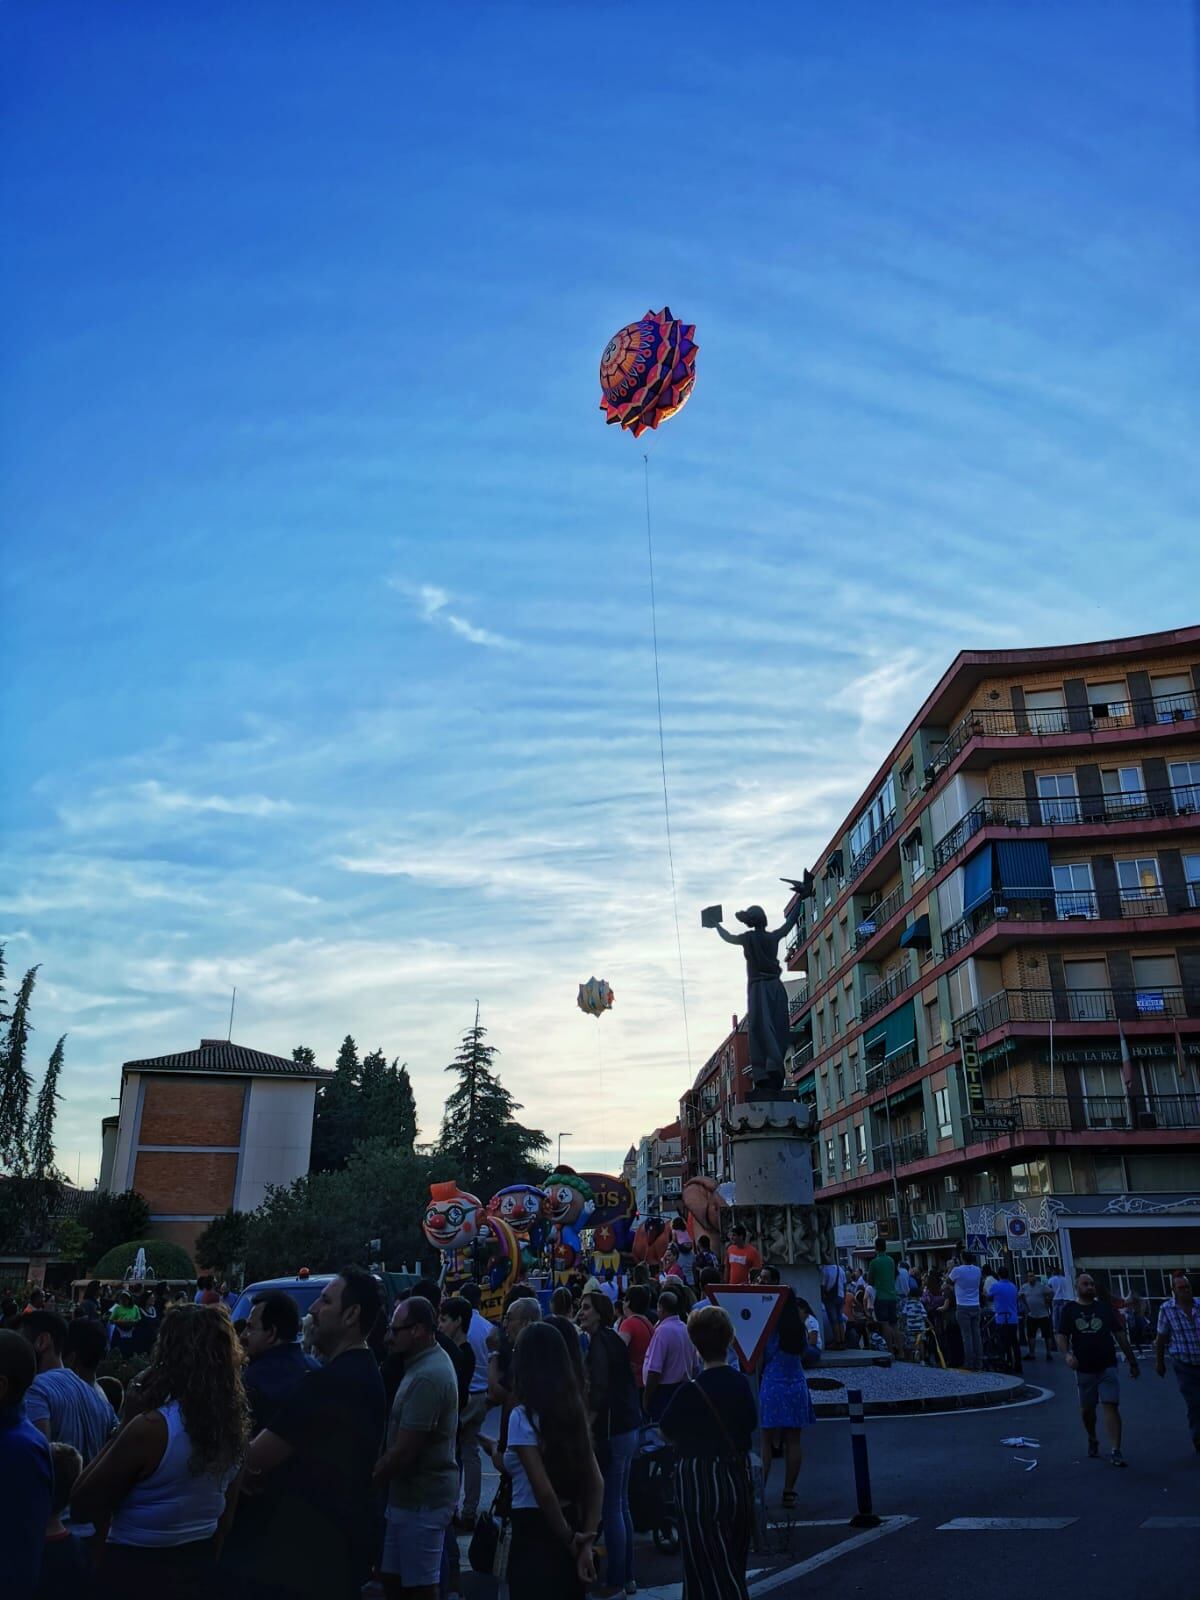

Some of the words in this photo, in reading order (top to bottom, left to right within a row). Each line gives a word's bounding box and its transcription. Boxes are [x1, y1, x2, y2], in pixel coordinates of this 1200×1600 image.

[1085, 1052, 1097, 1061] LA
[1101, 1050, 1118, 1061] PAZ
[1132, 1046, 1166, 1057] HOTEL
[963, 1036, 986, 1114] HOTEL
[980, 1119, 991, 1128] LA
[992, 1118, 1008, 1128] PAZ
